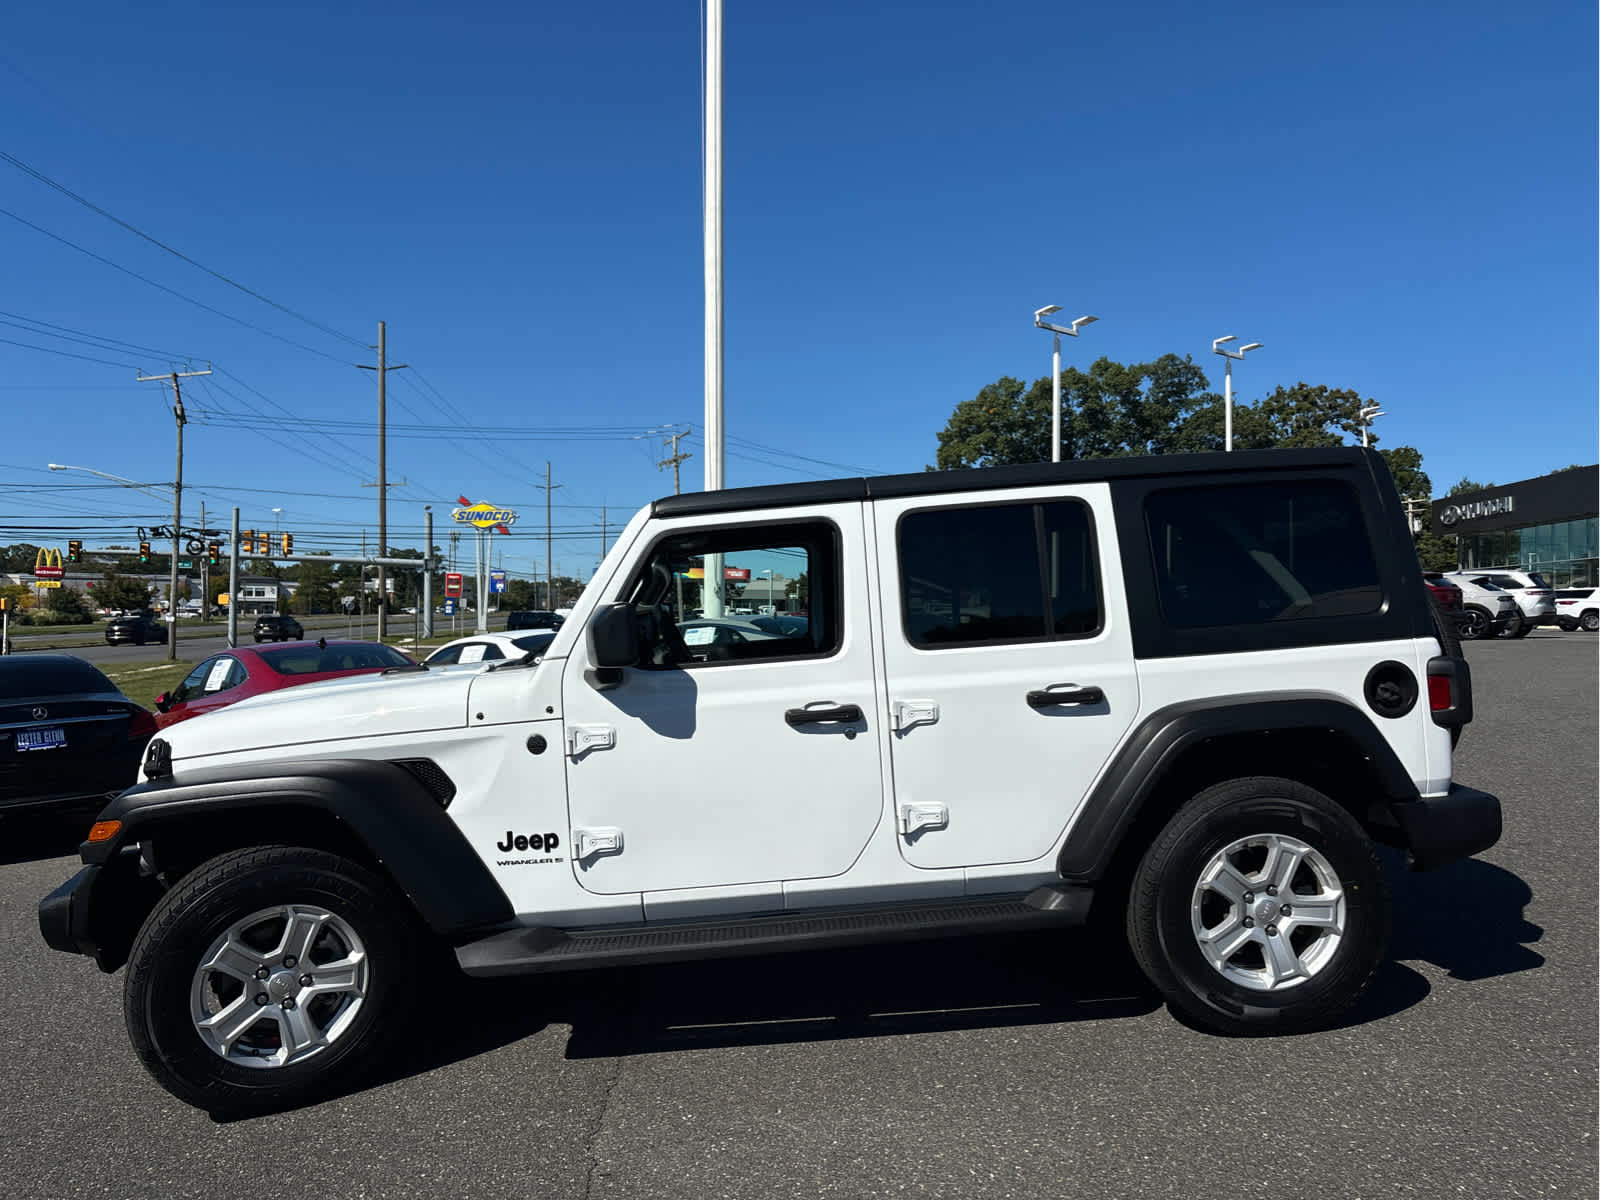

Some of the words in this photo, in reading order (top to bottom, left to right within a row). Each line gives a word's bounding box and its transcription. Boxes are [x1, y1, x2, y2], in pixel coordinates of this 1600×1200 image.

[456, 511, 511, 521] SUNOCO
[17, 731, 42, 746] LESTER
[43, 728, 65, 743] GLENN
[496, 830, 560, 853] Jeep
[496, 858, 553, 866] WRANGLER
